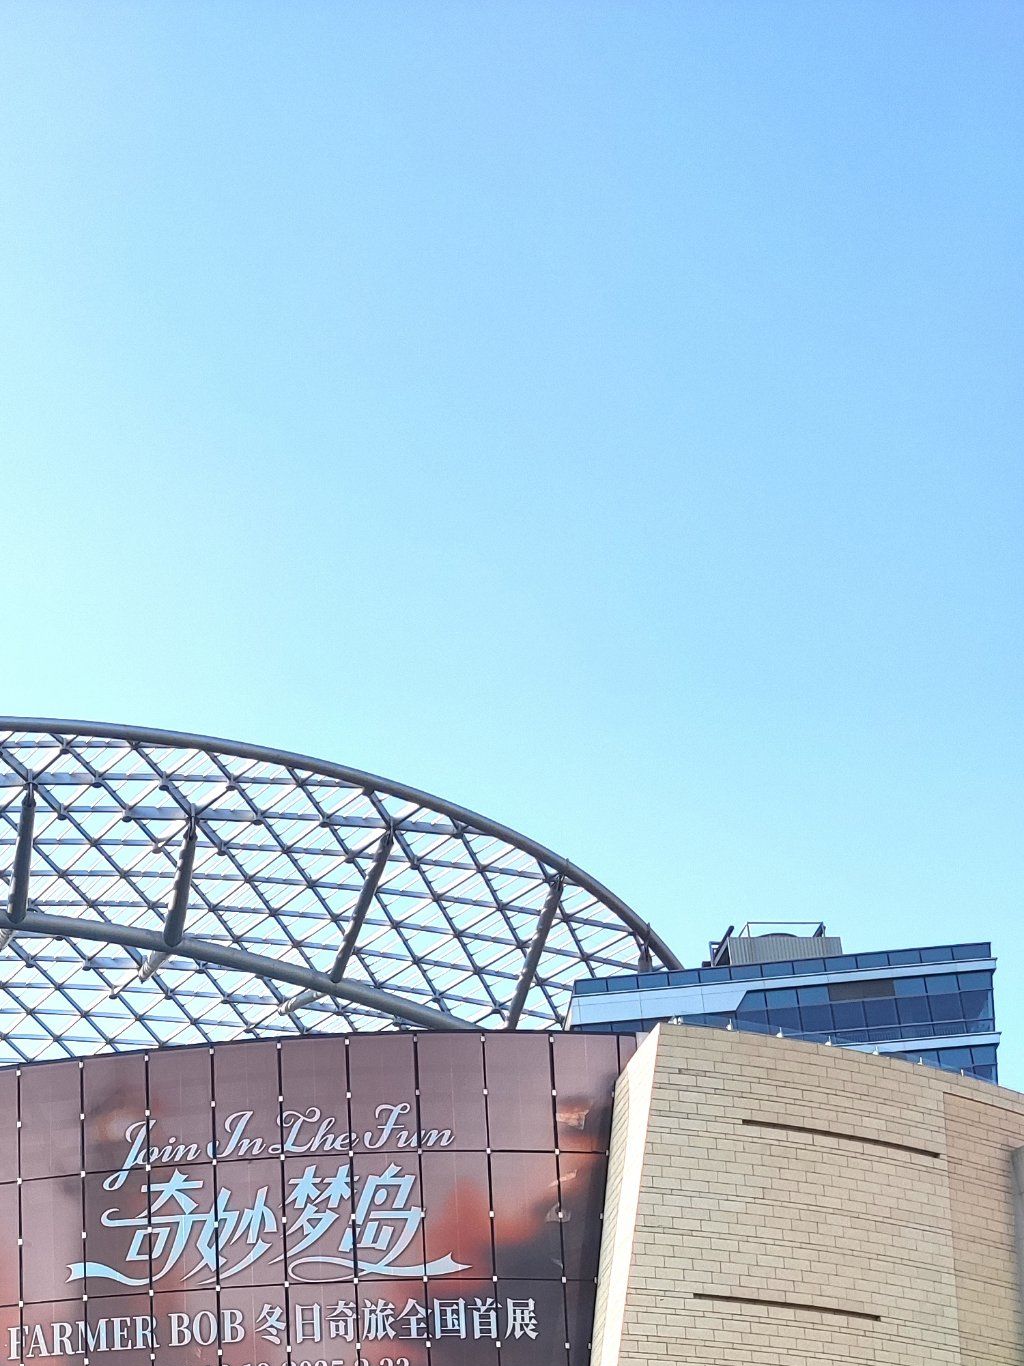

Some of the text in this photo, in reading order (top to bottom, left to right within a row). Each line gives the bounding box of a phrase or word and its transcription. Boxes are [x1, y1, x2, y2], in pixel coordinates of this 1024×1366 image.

[103, 1102, 454, 1191] Join In The Fun
[66, 1162, 472, 1286] 奇妙梦岛
[7, 1297, 540, 1360] FARMER BOB 冬日奇旅全国首展
